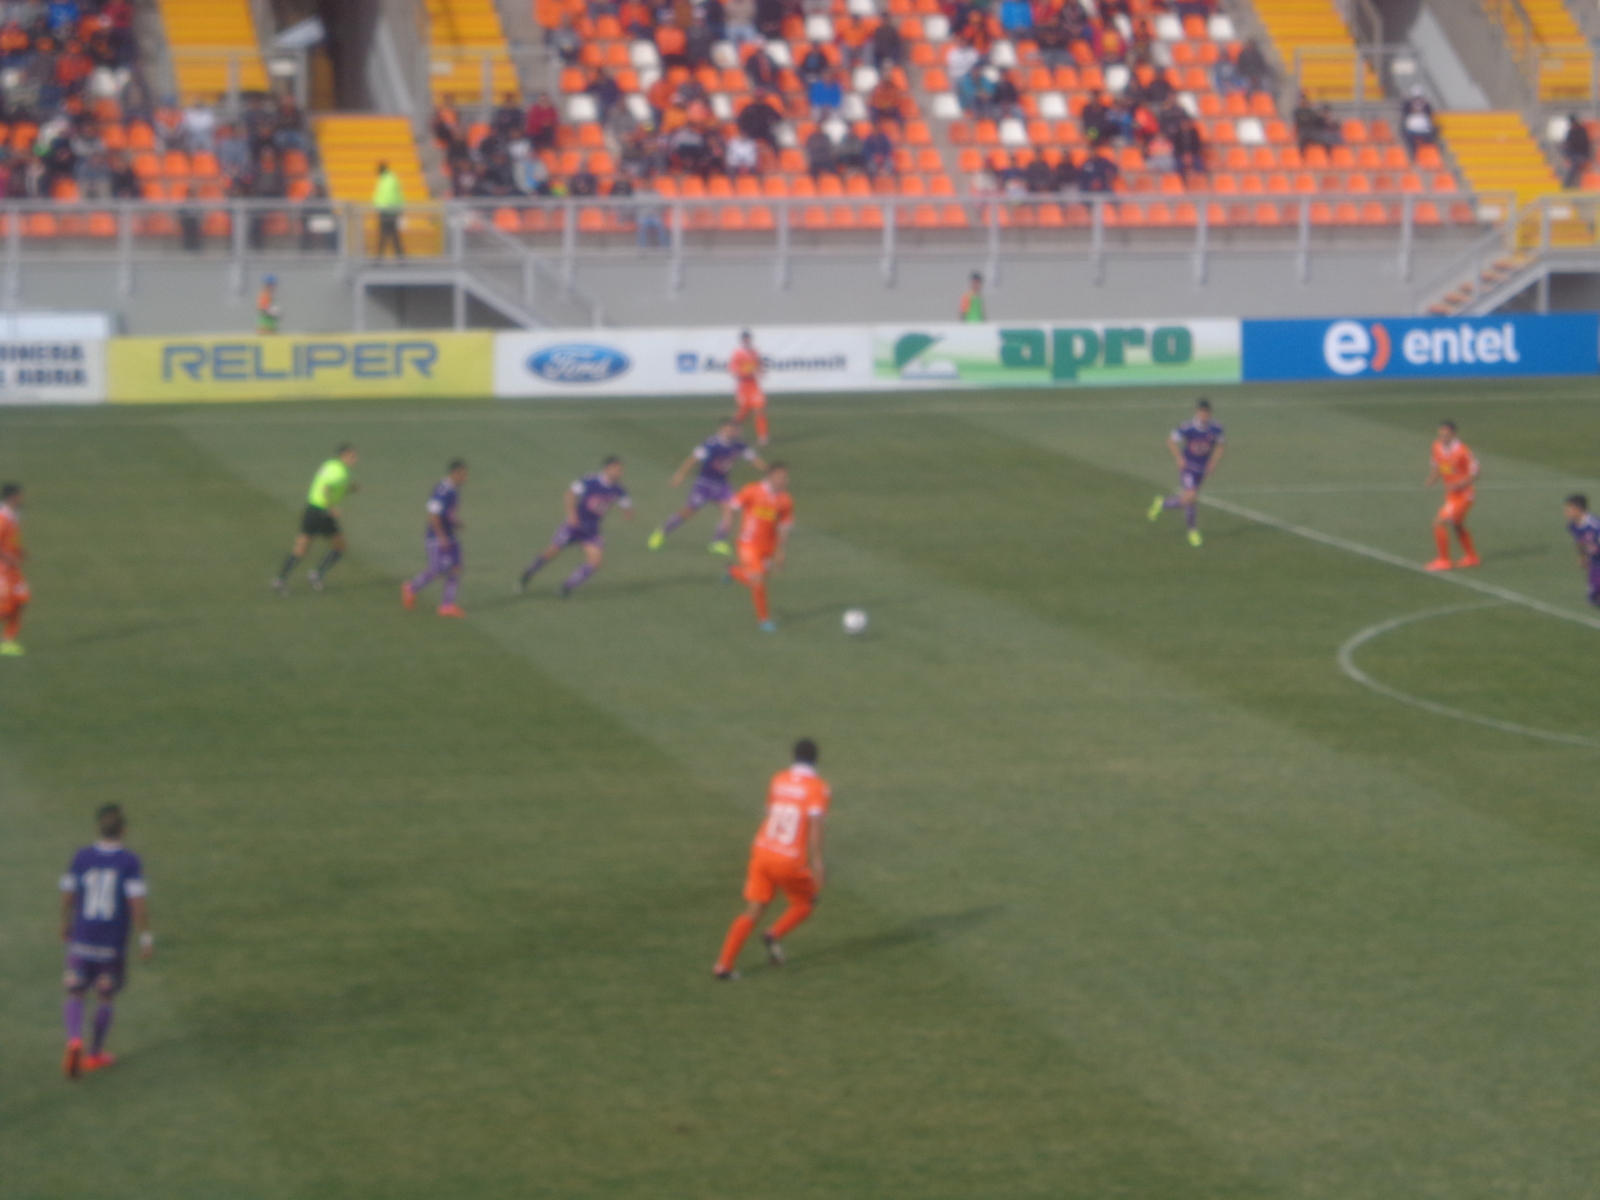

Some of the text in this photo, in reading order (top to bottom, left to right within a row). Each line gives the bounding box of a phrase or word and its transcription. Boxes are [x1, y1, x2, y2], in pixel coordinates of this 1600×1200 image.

[162, 341, 439, 382] RELIPER
[542, 348, 613, 379] Ford
[998, 325, 1193, 379] apro
[1402, 322, 1520, 364] entel
